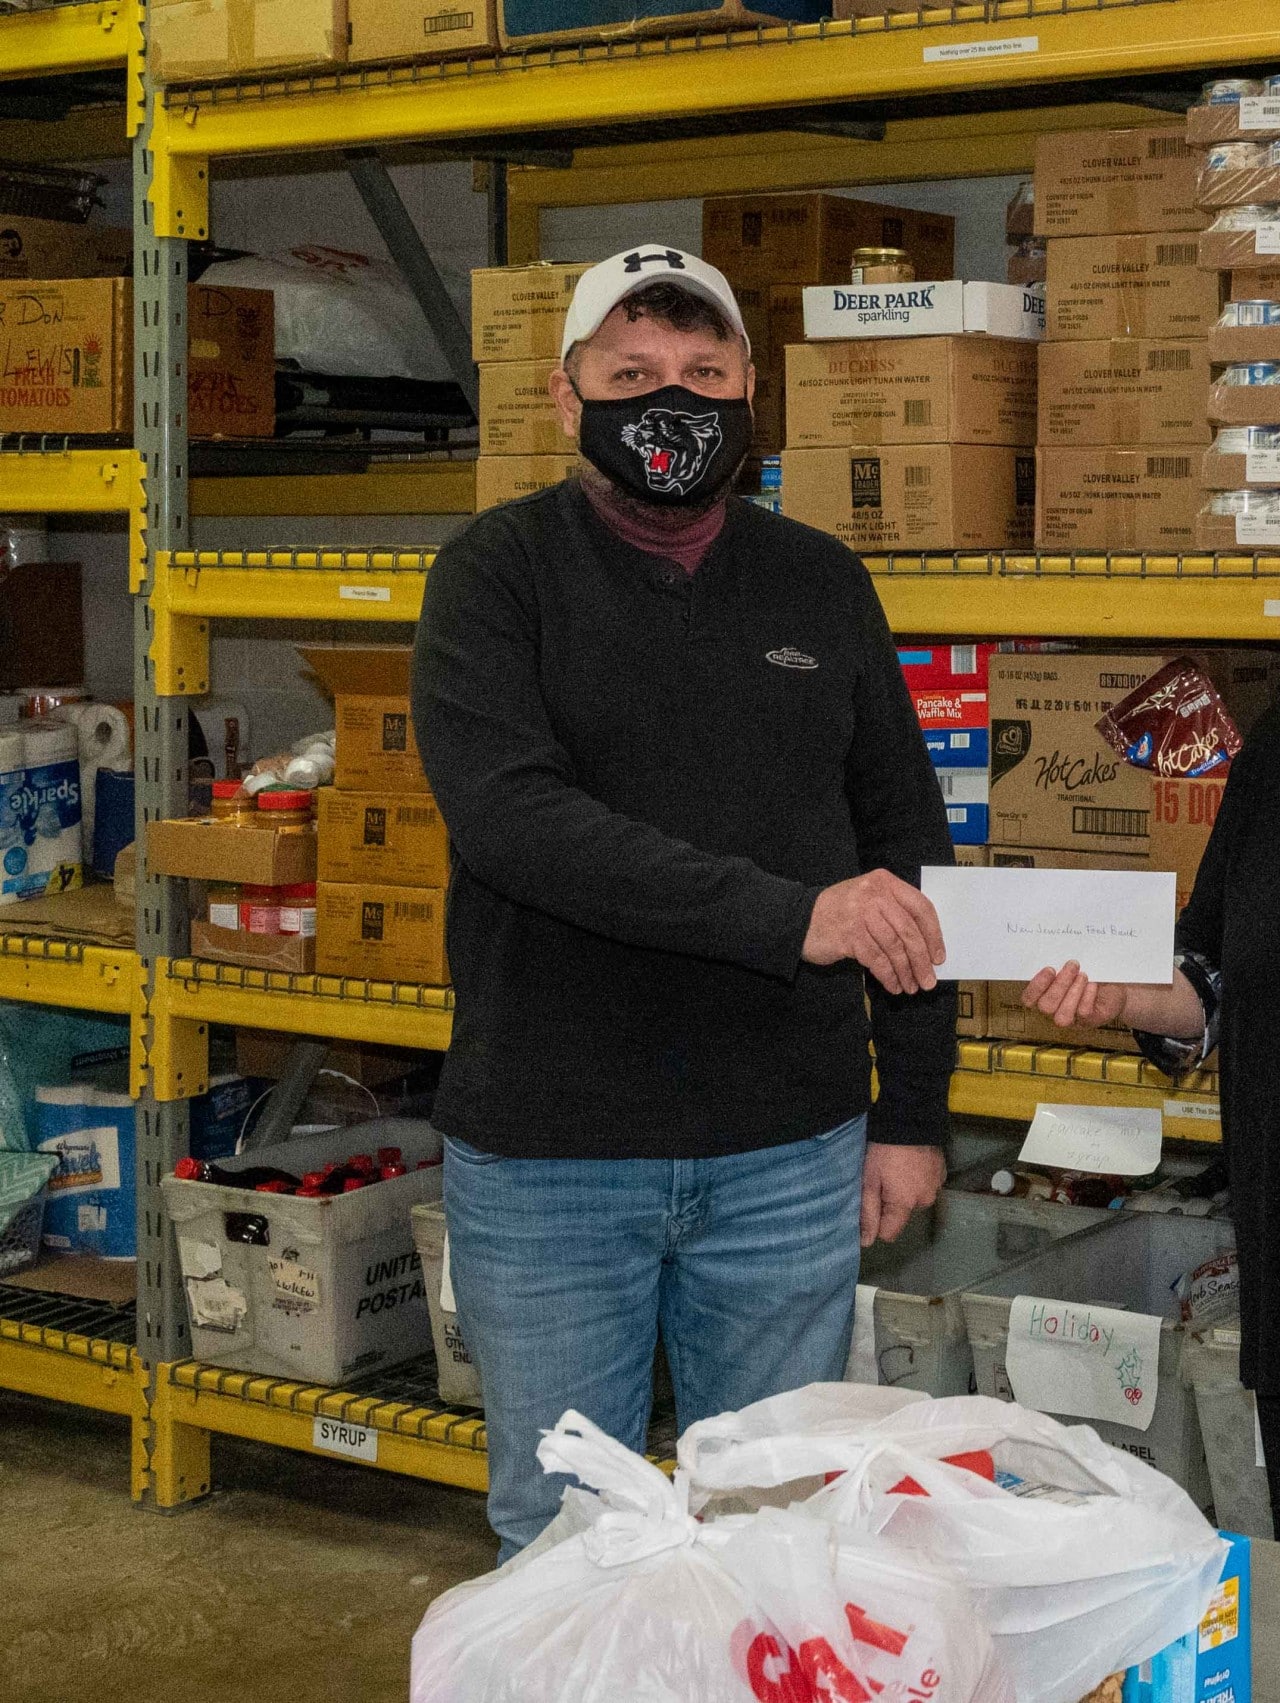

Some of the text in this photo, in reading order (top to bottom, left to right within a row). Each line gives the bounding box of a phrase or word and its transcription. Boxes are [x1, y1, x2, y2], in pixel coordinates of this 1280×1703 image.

[1082, 157, 1141, 168] CLOVER VALLEY
[1093, 264, 1149, 274] CLOVER VALLEY
[512, 291, 559, 301] CLOVER VALLEY
[833, 286, 935, 311] DEER PARK
[1023, 292, 1045, 314] DEE
[858, 309, 910, 323] sparkling
[828, 360, 895, 374] DUCHESS
[1084, 368, 1141, 379] CLOVER VALLEY
[824, 378, 850, 386] CHUNK
[904, 375, 930, 383] WATER
[1083, 474, 1140, 483] CLOVER VALLEY
[871, 511, 884, 520] OZ
[836, 522, 897, 532] CHUNK LIGHT
[868, 532, 900, 541] WATER
[917, 697, 962, 709] Pancake &
[918, 708, 962, 719] Waffle Mix
[10, 779, 80, 815] Sparkle
[1056, 794, 1096, 803] TRADITIONAL
[1154, 781, 1224, 827] 15 DO
[58, 864, 76, 892] 4
[1006, 922, 1034, 934] New
[1182, 1106, 1208, 1115] USE This
[366, 1252, 422, 1286] UNITE
[1028, 1304, 1116, 1357] Holiday
[320, 1423, 367, 1448] SYRUP
[1112, 1441, 1156, 1460] ABEL
